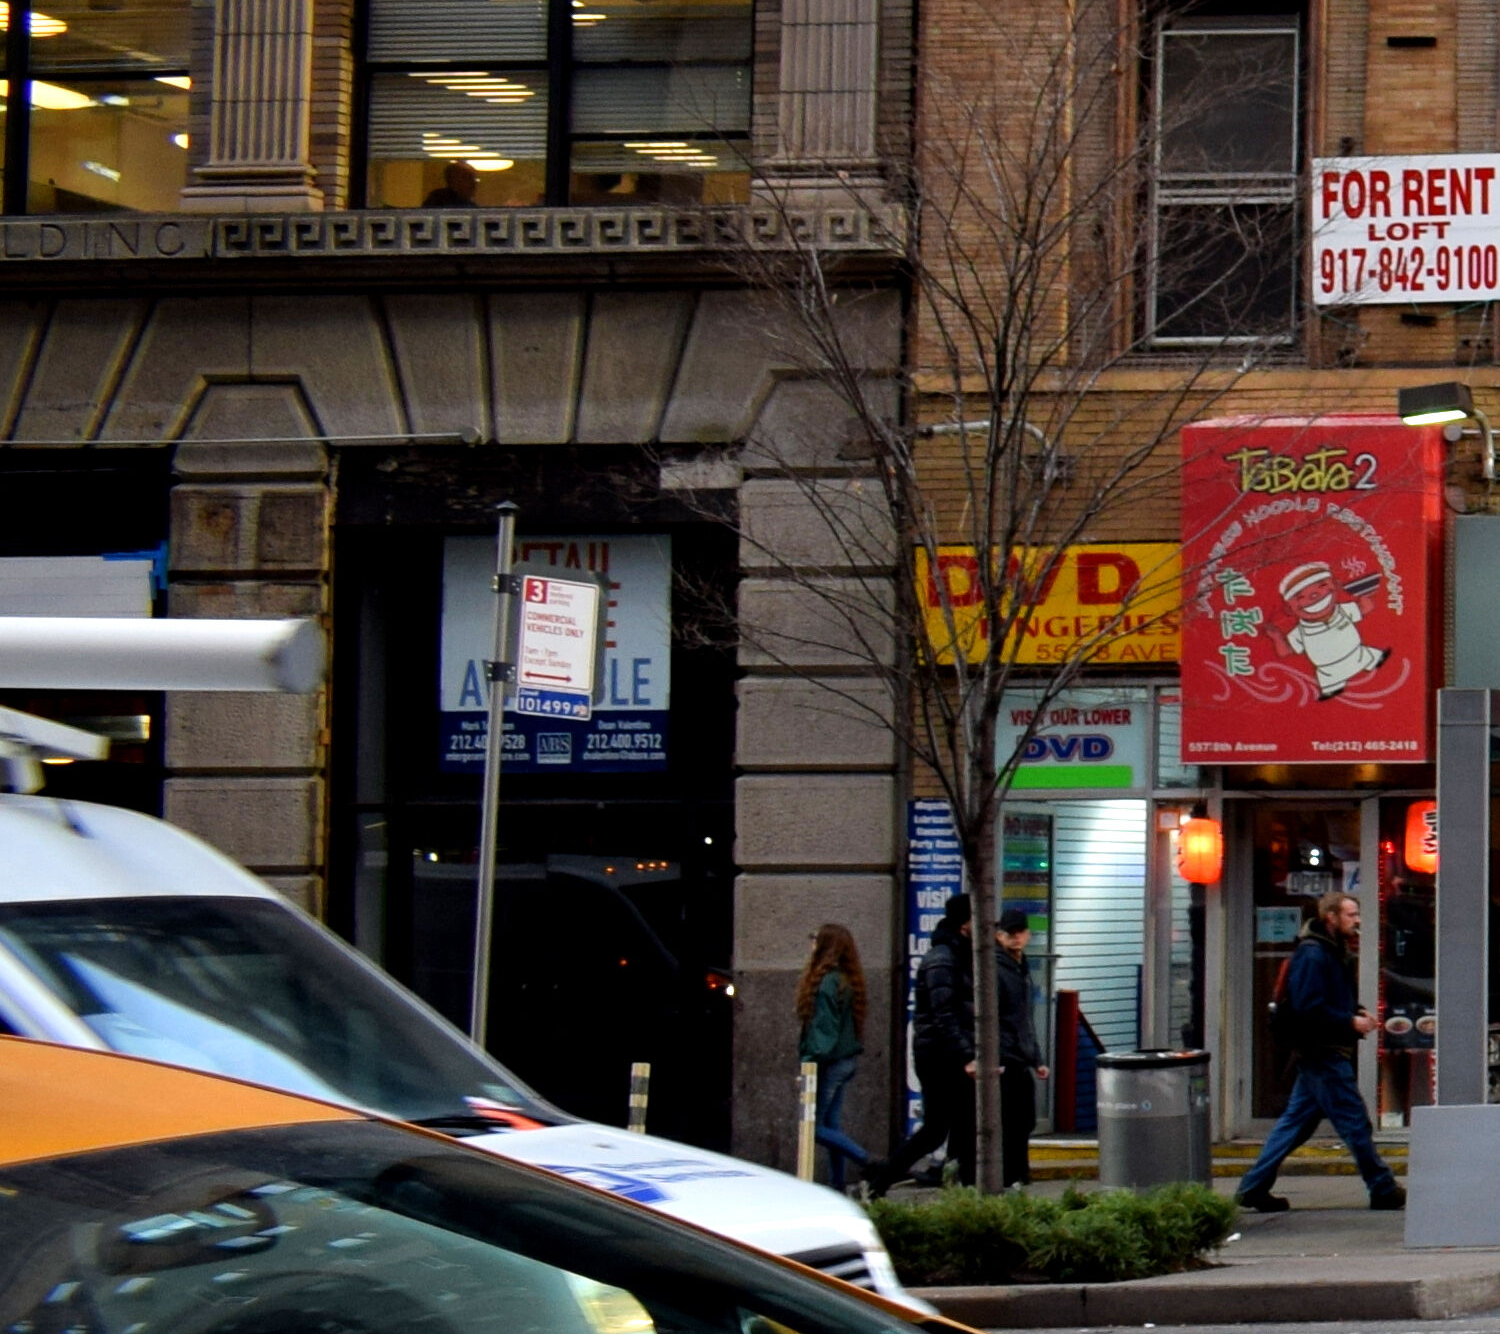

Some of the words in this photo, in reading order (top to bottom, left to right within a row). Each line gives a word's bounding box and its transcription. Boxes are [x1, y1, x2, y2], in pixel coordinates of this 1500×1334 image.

[1321, 169, 1391, 219] FOR
[1402, 167, 1496, 217] RENT
[1367, 221, 1452, 242] LOFT
[1320, 244, 1498, 294] 917-842-9100
[1355, 453, 1378, 491] 2
[927, 550, 1142, 608] DVD
[530, 581, 544, 602] 3
[1215, 567, 1264, 677] たばた
[1119, 643, 1176, 660] AVE
[519, 696, 573, 715] 101499
[1049, 709, 1080, 726] OUR
[1084, 708, 1132, 726] LOWER
[1019, 734, 1113, 762] DVD
[1234, 740, 1278, 753] Avenue
[916, 886, 953, 909] visit
